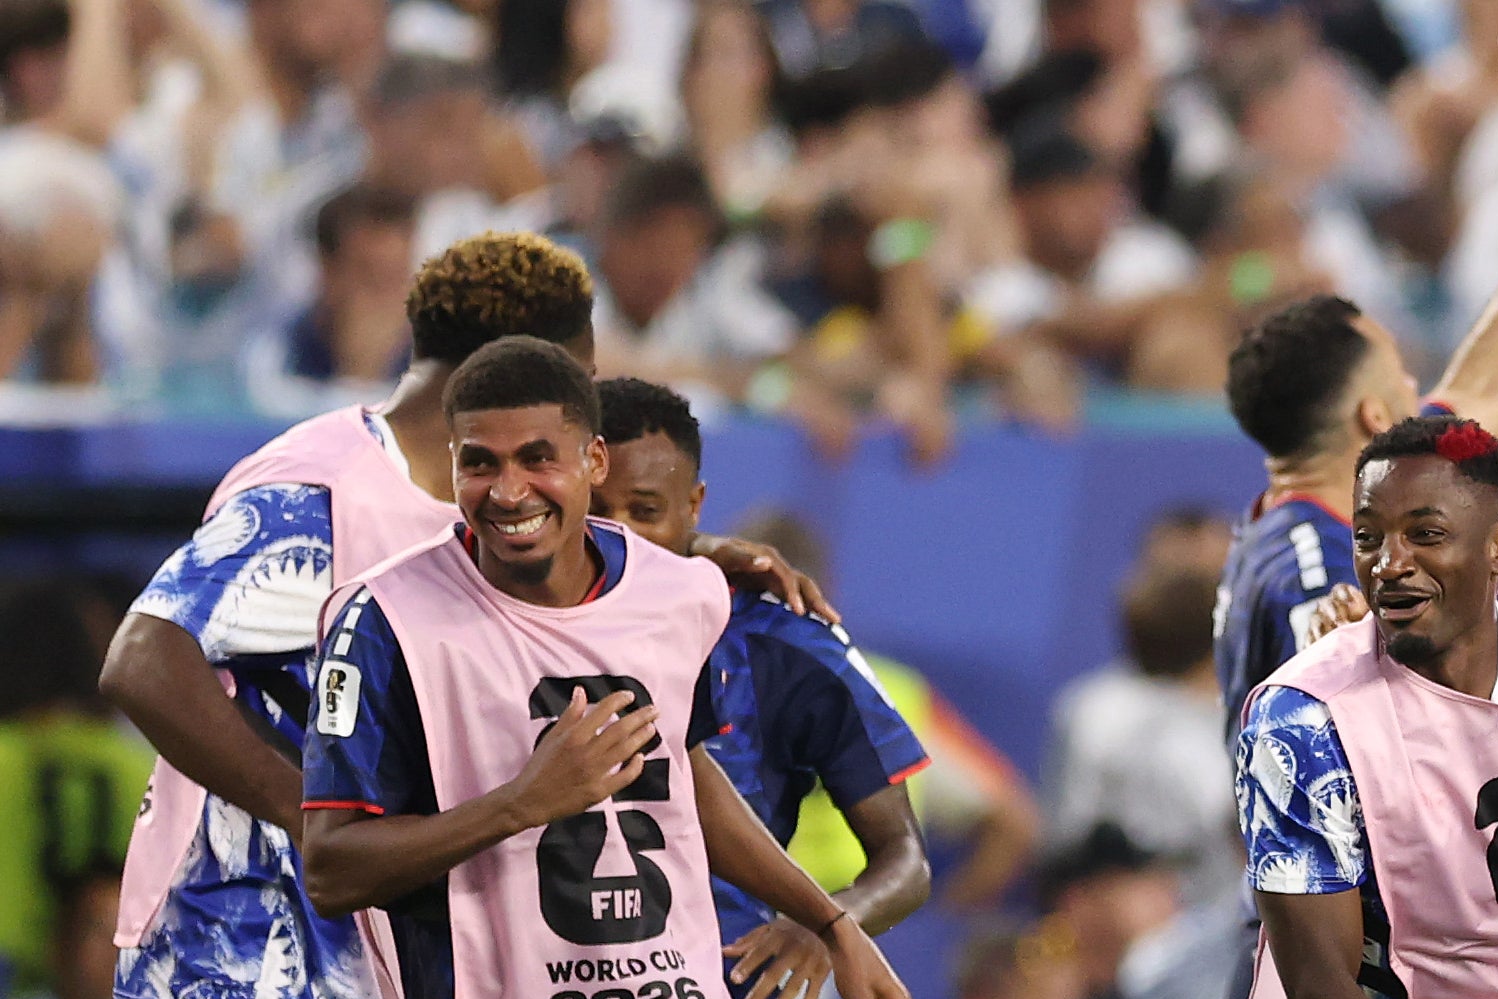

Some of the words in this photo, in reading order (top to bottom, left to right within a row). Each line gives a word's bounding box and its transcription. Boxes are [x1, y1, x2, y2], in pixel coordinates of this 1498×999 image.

[591, 888, 642, 920] FIFA
[545, 957, 647, 984] WORLD
[649, 948, 686, 972] CUP
